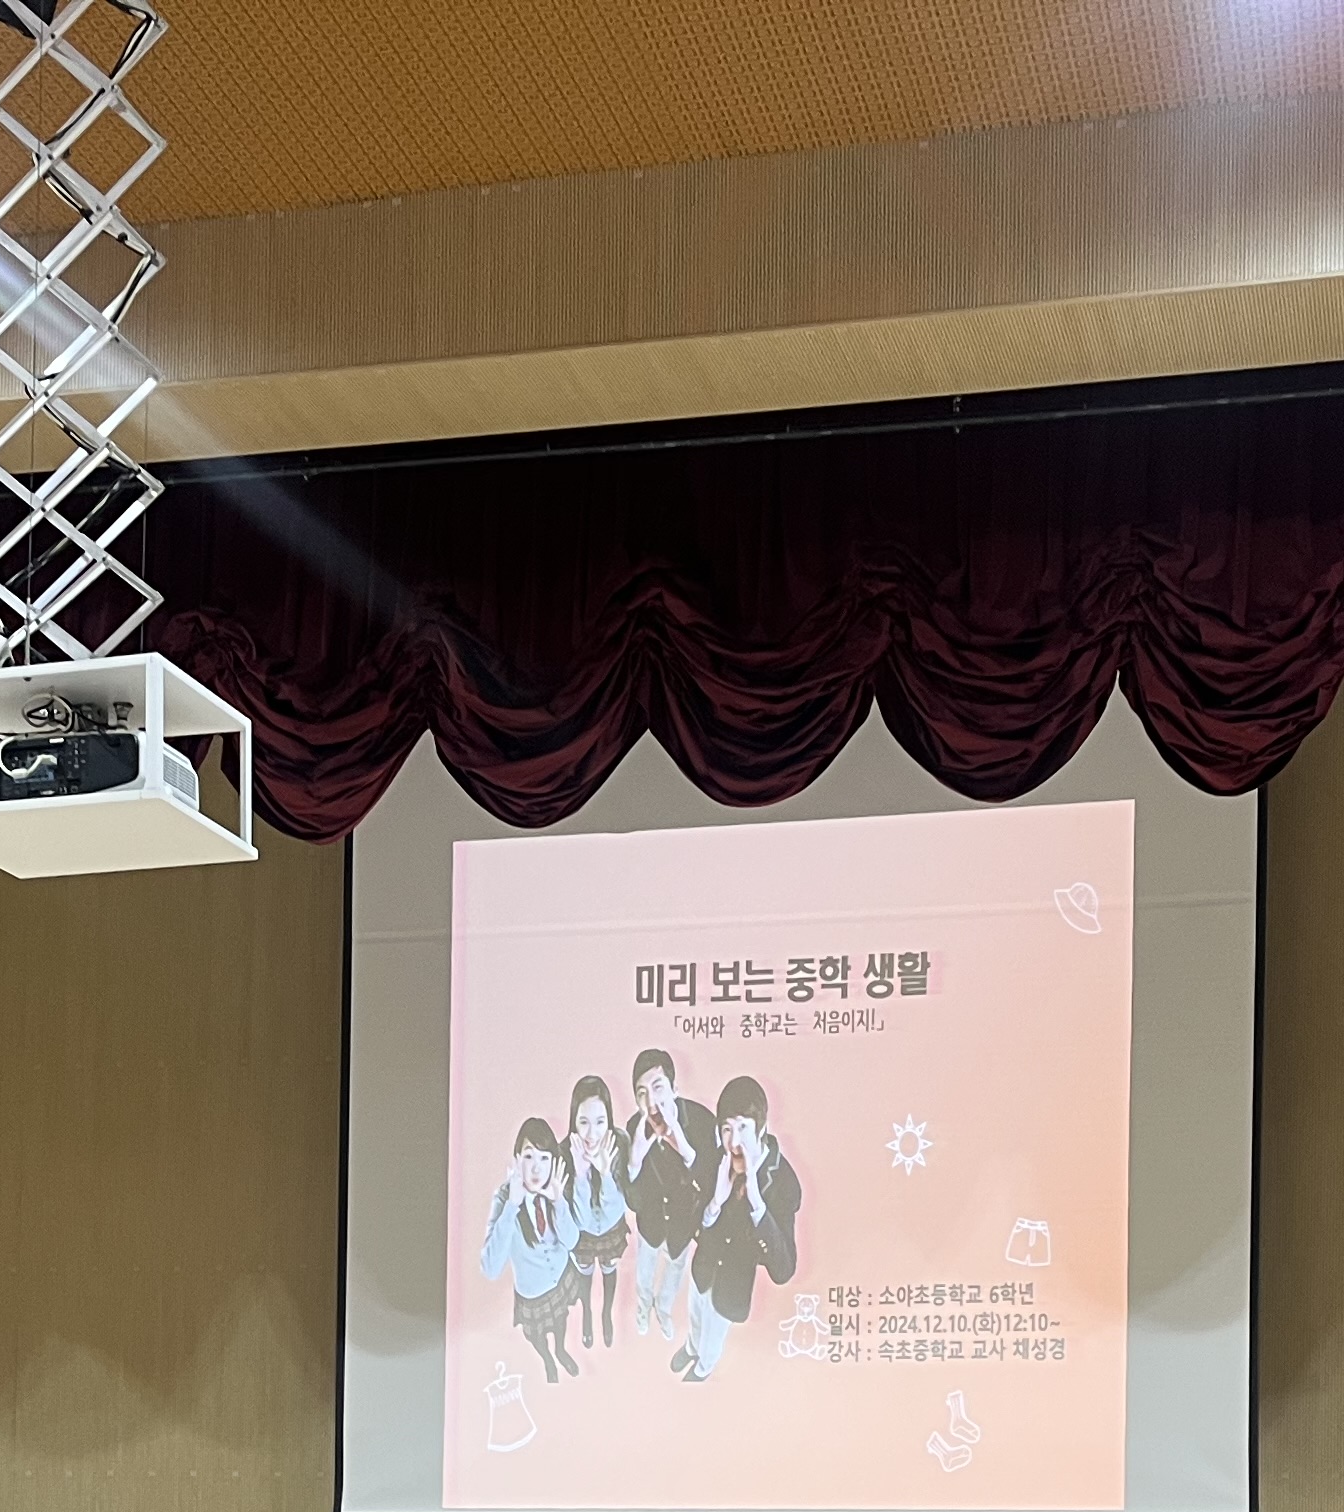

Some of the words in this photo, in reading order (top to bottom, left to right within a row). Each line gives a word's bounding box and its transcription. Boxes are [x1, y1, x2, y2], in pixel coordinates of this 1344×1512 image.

[635, 962, 697, 1008] 미리
[710, 960, 775, 1003] 보는
[785, 955, 852, 1002] 중학
[863, 951, 931, 999] 생활
[674, 1014, 726, 1040] 「어서와
[739, 1012, 798, 1037] 중학교는
[813, 1008, 885, 1035] 처음이지!」
[828, 1285, 862, 1308] 대상
[878, 1283, 983, 1307] 소야초등학교
[989, 1282, 1035, 1306] 6학년
[828, 1313, 861, 1336] 일시
[827, 1340, 861, 1364] 강사
[878, 1338, 965, 1362] 속초중학교
[971, 1337, 1006, 1361] 교사
[1012, 1337, 1066, 1361] 채성경
